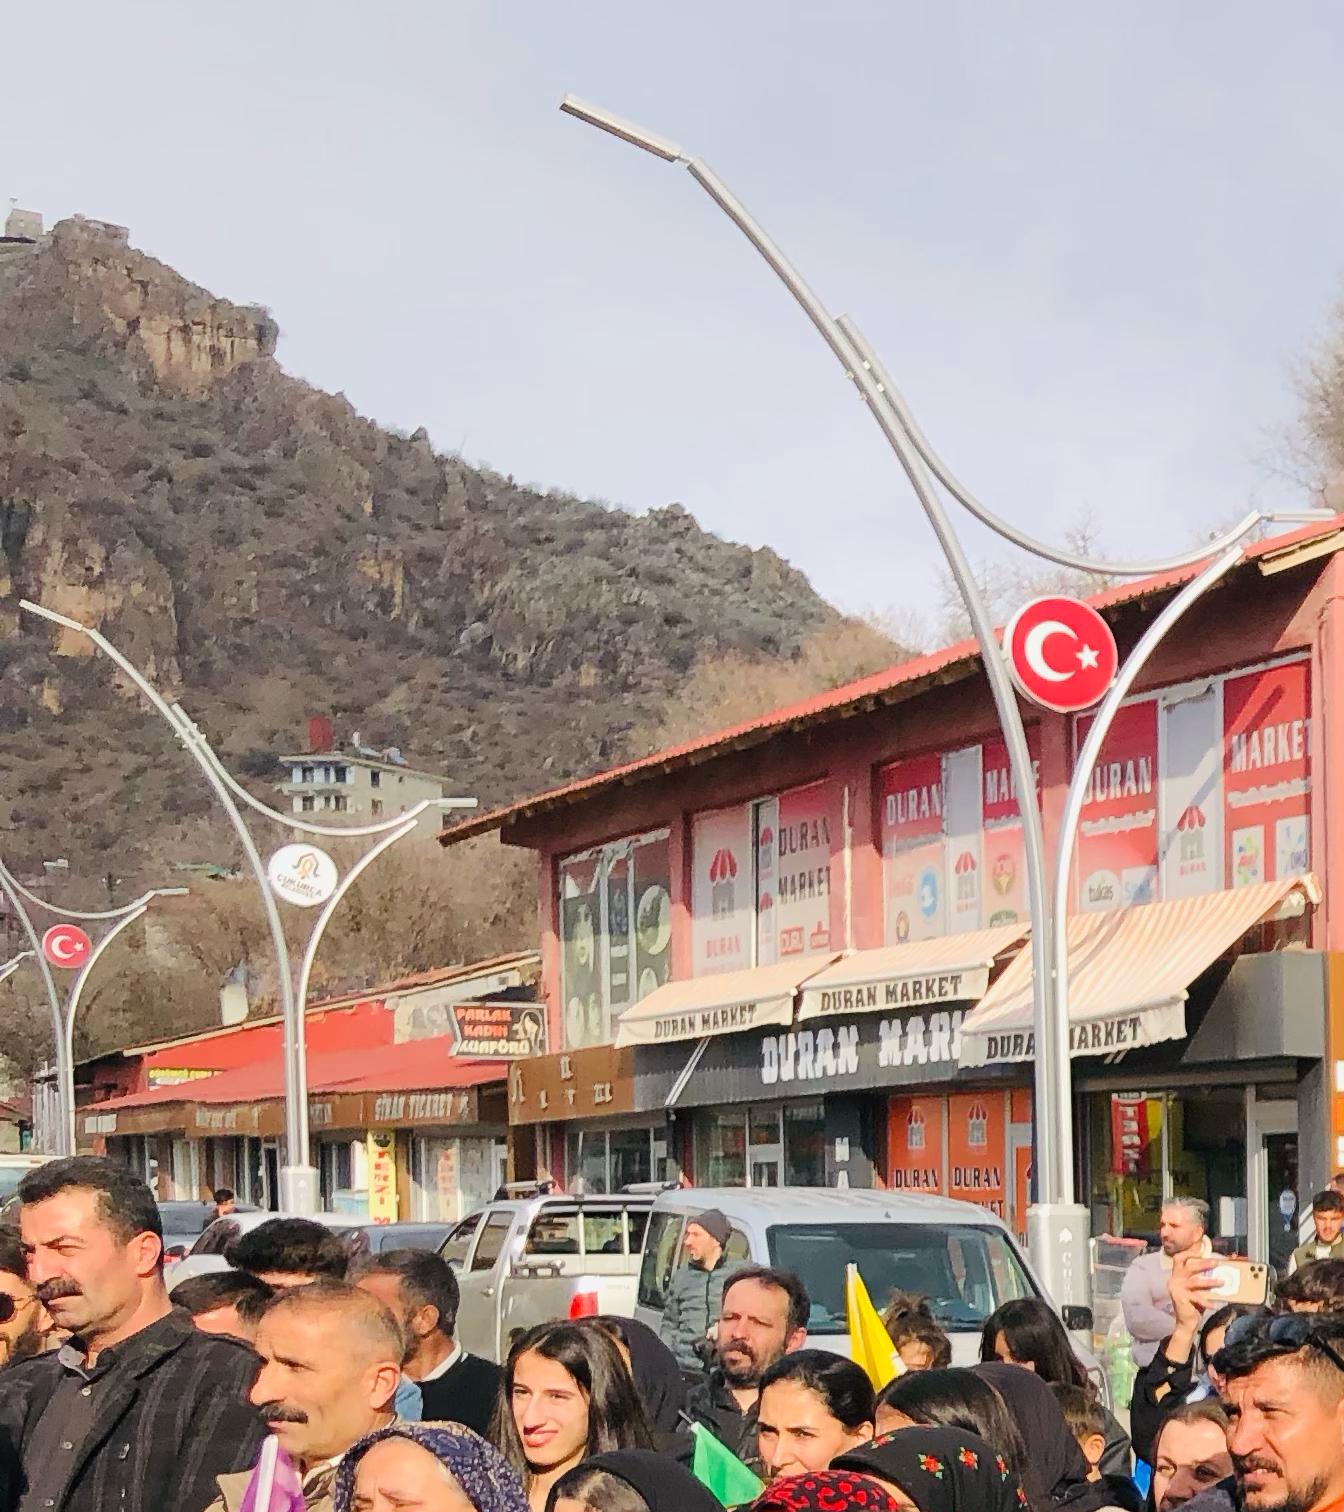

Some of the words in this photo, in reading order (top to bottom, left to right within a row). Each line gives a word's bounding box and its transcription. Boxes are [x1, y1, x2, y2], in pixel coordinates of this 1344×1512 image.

[886, 783, 942, 826] DURAN
[779, 816, 831, 857] DURAN
[779, 866, 831, 904] MARKET
[820, 985, 878, 1013] DURAN
[885, 974, 962, 1004] MARKET
[456, 1008, 512, 1022] PARLAK
[463, 1024, 508, 1037] KADIN
[655, 1016, 696, 1039] DURAN
[702, 1003, 757, 1032] MARKET
[761, 1023, 860, 1084] DURAN
[987, 1033, 1034, 1060] DURA
[895, 1167, 938, 1189] DURAN
[953, 1166, 1001, 1190] DURAN
